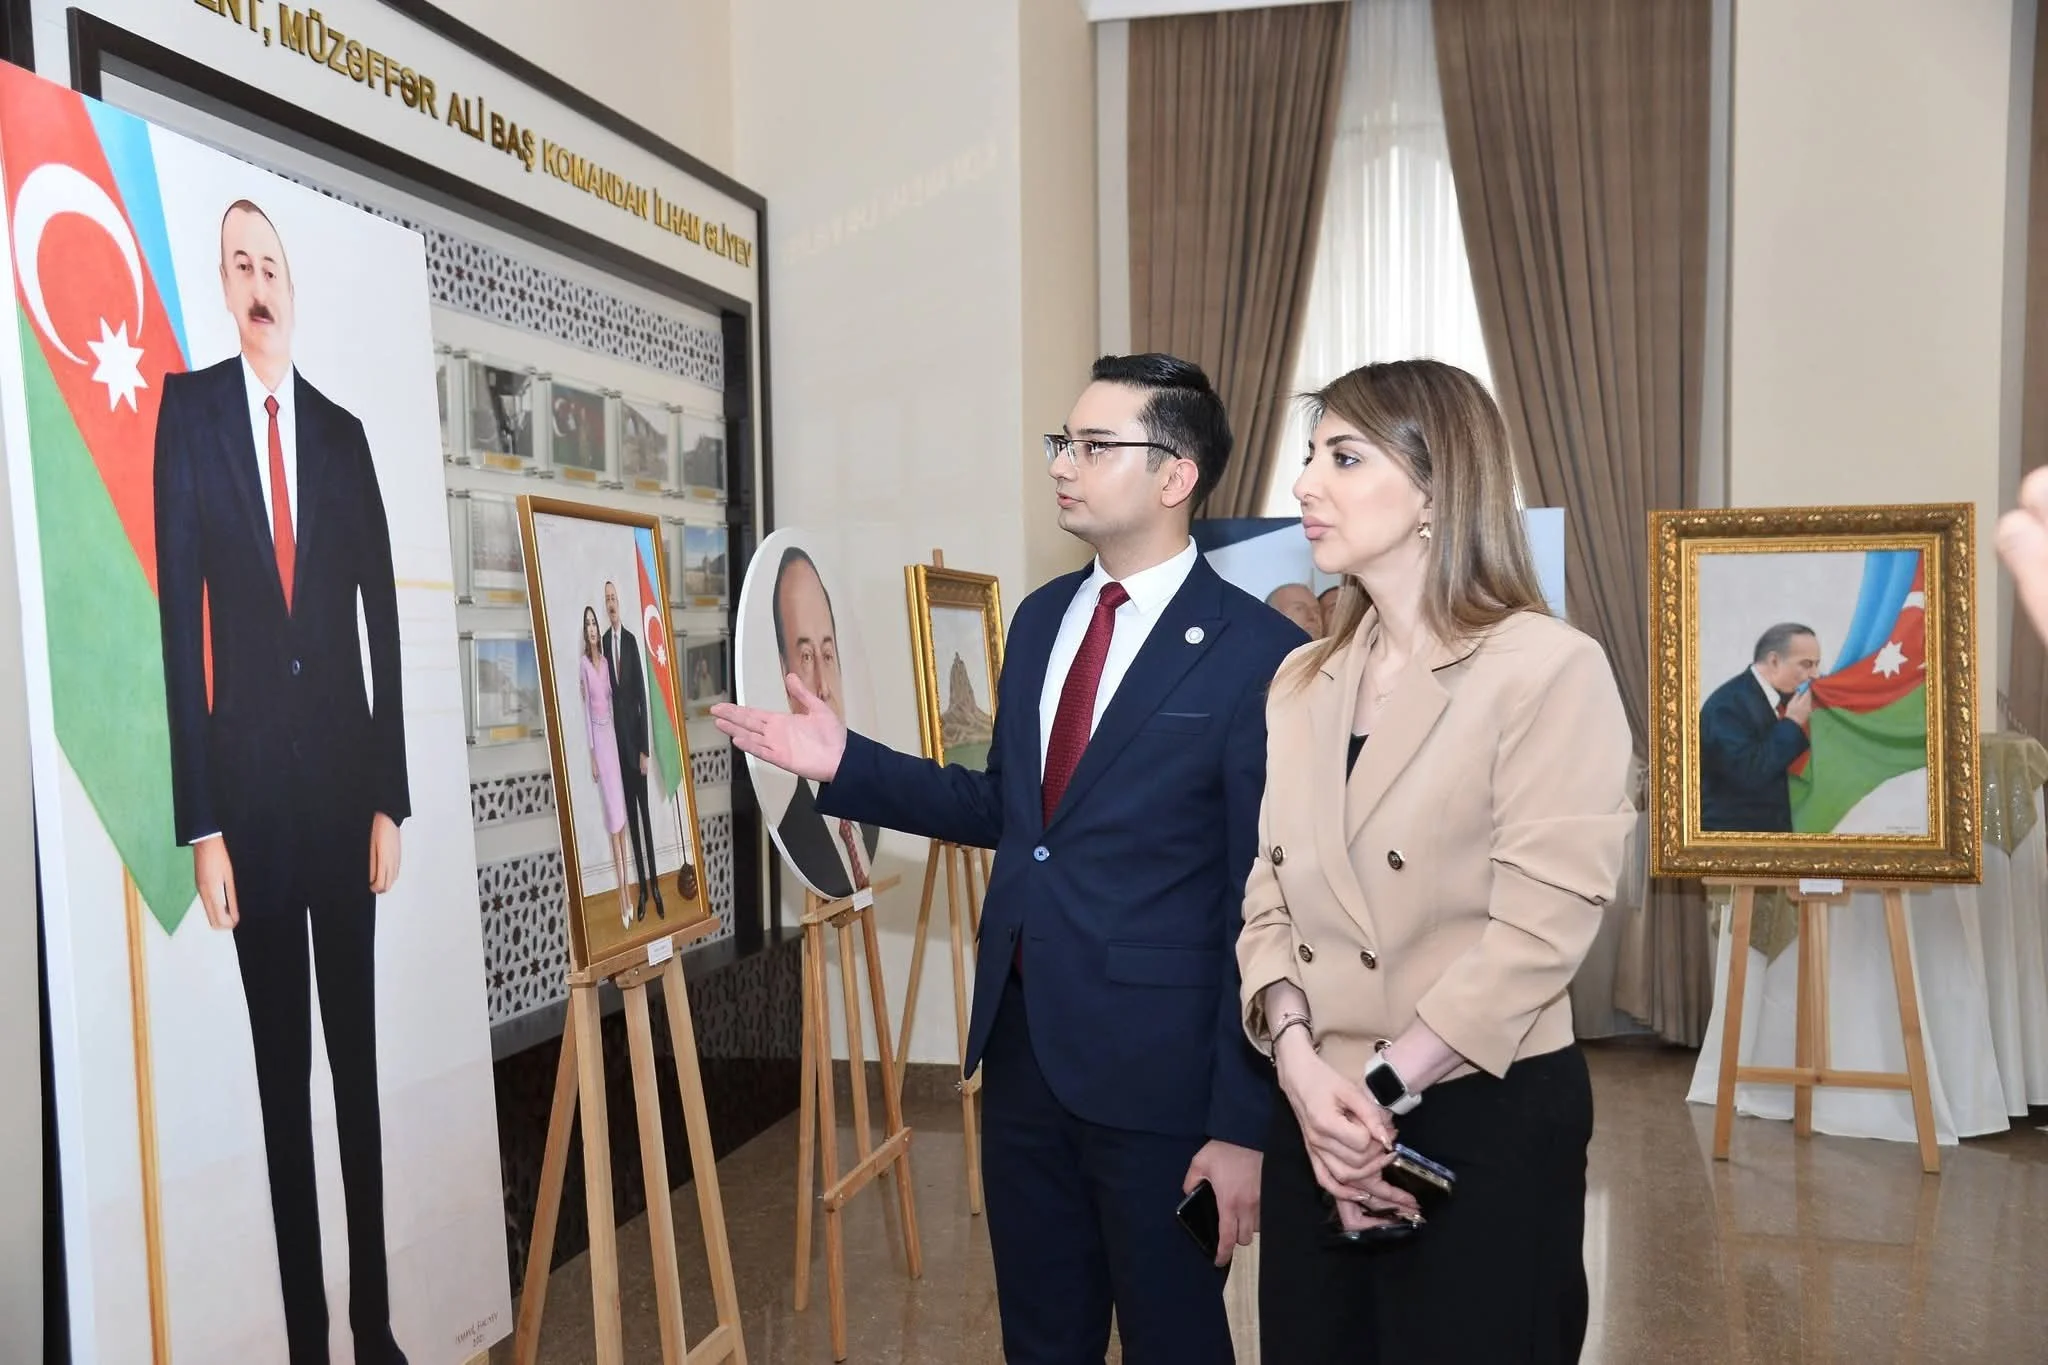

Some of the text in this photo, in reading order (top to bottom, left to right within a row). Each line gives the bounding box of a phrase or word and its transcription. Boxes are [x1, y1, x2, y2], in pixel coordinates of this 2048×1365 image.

[279, 3, 439, 119] MÜZƏFFƏR
[490, 111, 536, 173] BAŞ
[542, 138, 648, 221] KOMANDAN
[653, 188, 701, 245] İLHAM
[704, 222, 751, 268] ƏLİYEV
